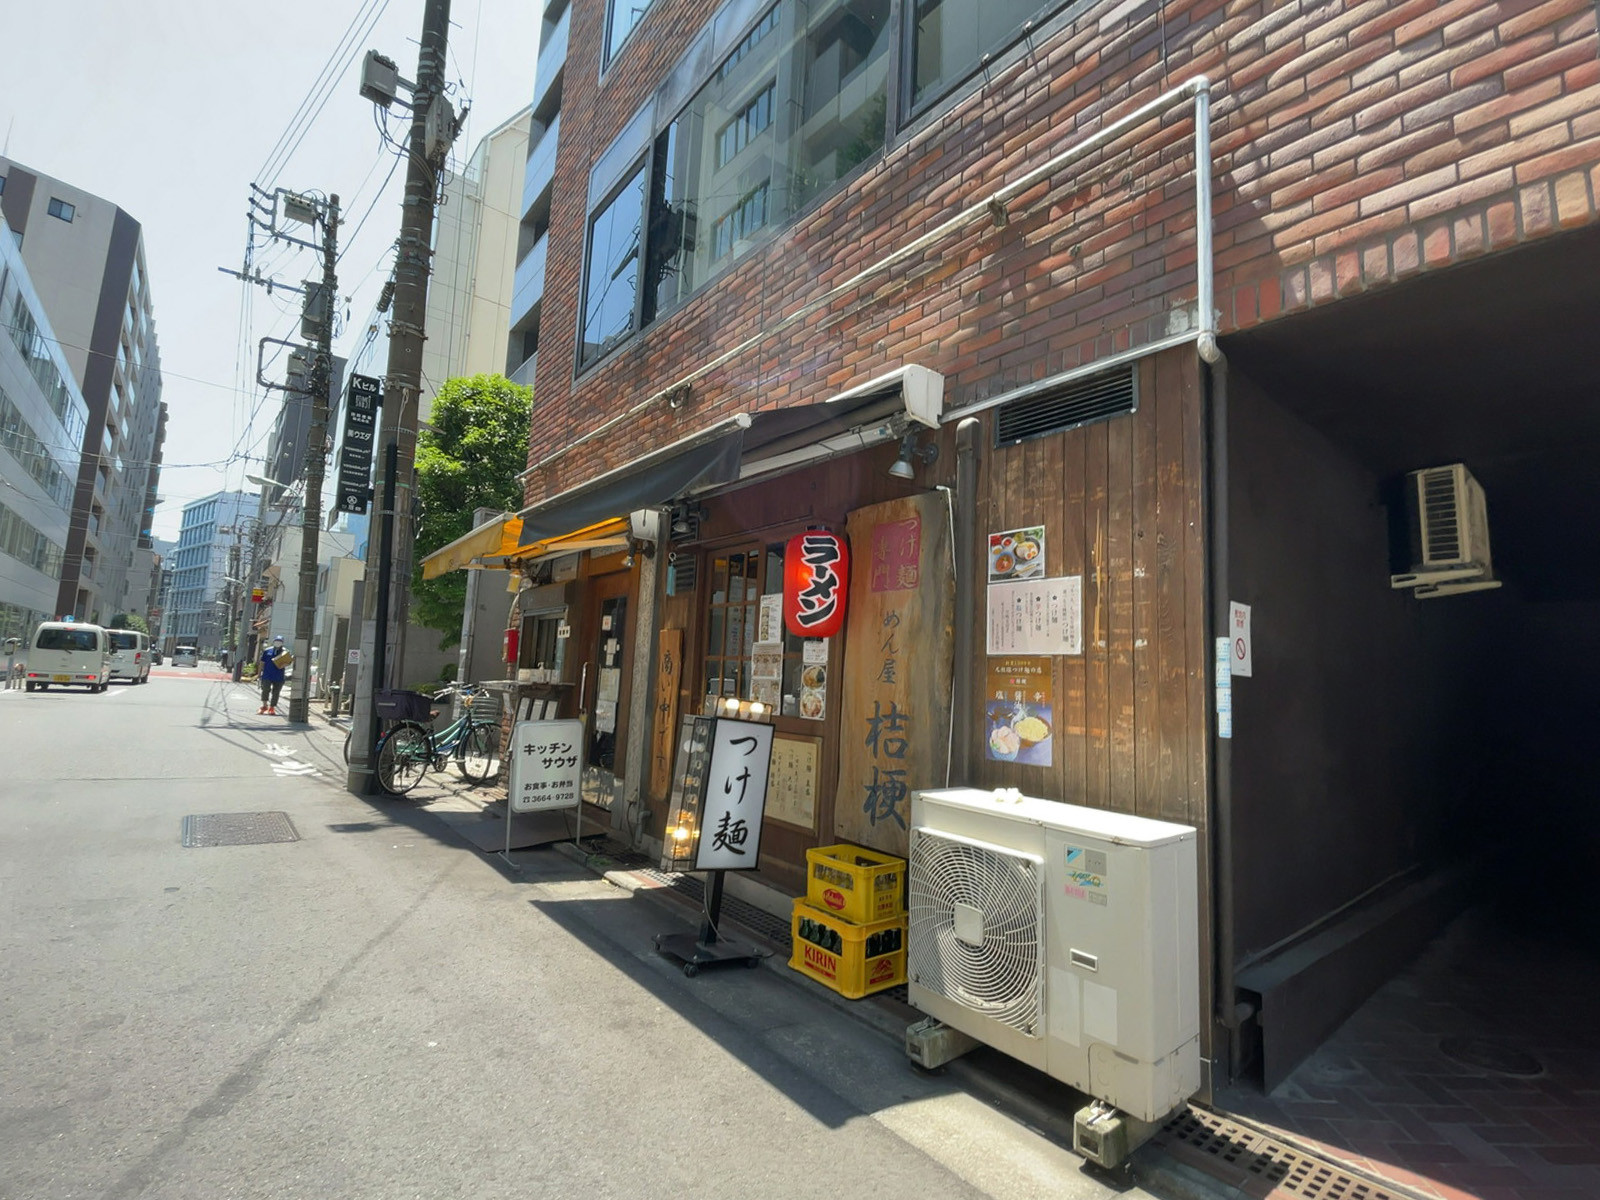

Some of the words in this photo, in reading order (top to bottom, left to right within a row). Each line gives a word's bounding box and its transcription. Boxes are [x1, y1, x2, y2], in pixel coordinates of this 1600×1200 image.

[352, 377, 377, 392] Kビル
[796, 536, 840, 627] ラーメン
[897, 519, 918, 588] つけ麺
[877, 610, 901, 684] めん屋
[523, 742, 572, 756] キッチン
[542, 755, 577, 769] サウザ
[863, 700, 910, 831] 桔梗
[712, 735, 758, 856] つけ麺
[804, 945, 836, 973] KIRIN
